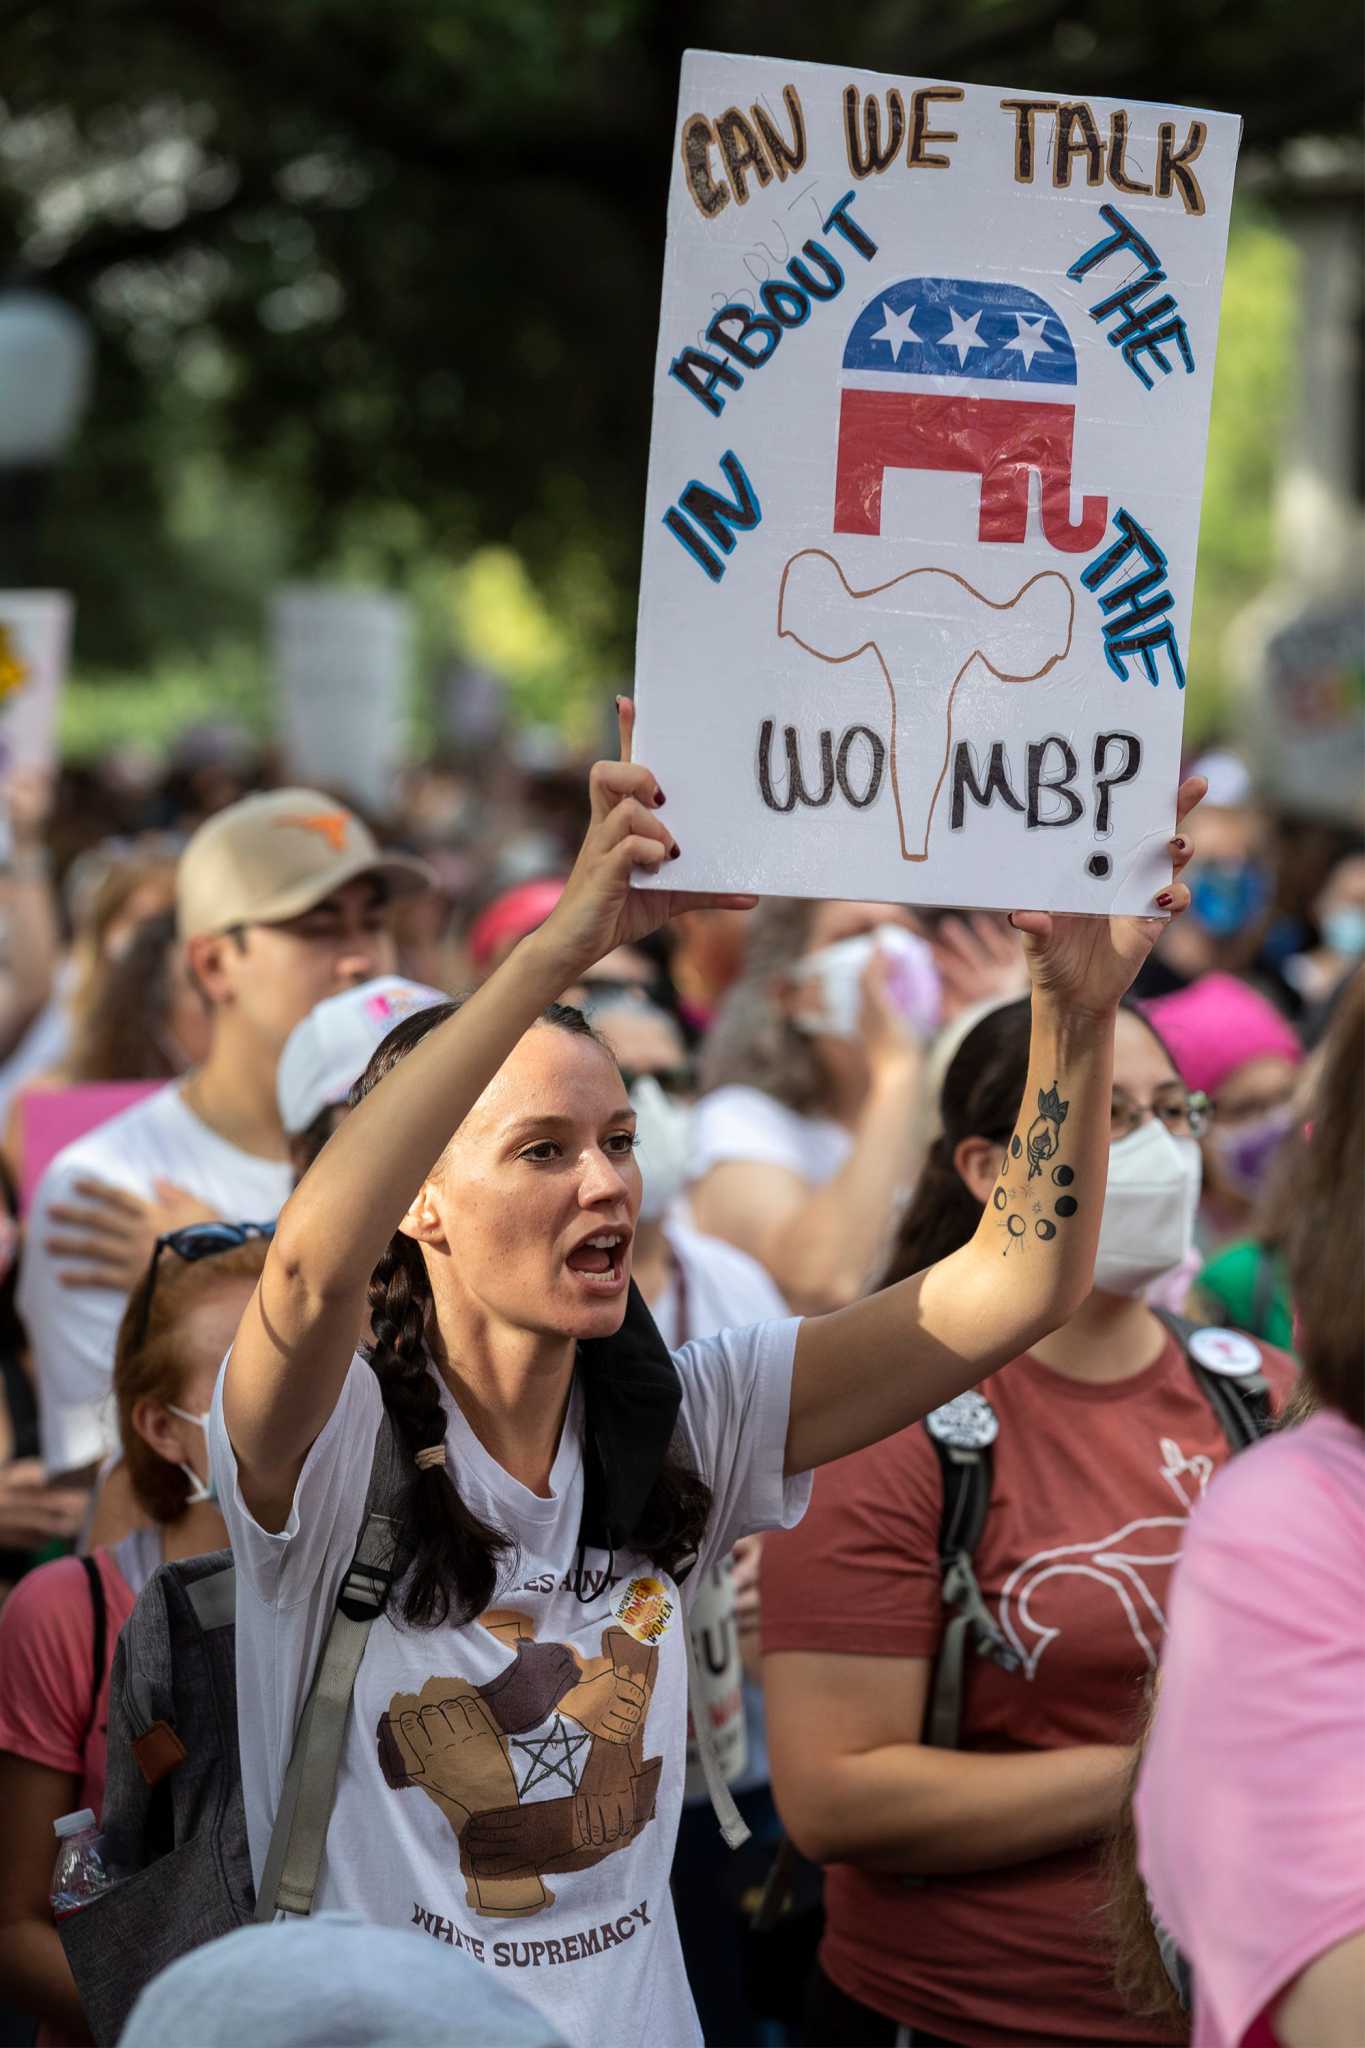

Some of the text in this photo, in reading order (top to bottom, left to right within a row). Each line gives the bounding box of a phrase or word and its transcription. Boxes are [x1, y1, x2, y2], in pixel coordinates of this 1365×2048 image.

[681, 84, 1206, 219] CAN WE TALK
[668, 190, 879, 417] ABOUT
[1066, 203, 1196, 391] THE
[662, 450, 762, 583] IN
[1080, 507, 1185, 689] THE
[647, 1600, 674, 1644] WOMEN
[492, 1899, 652, 1968] SUPREMACY
